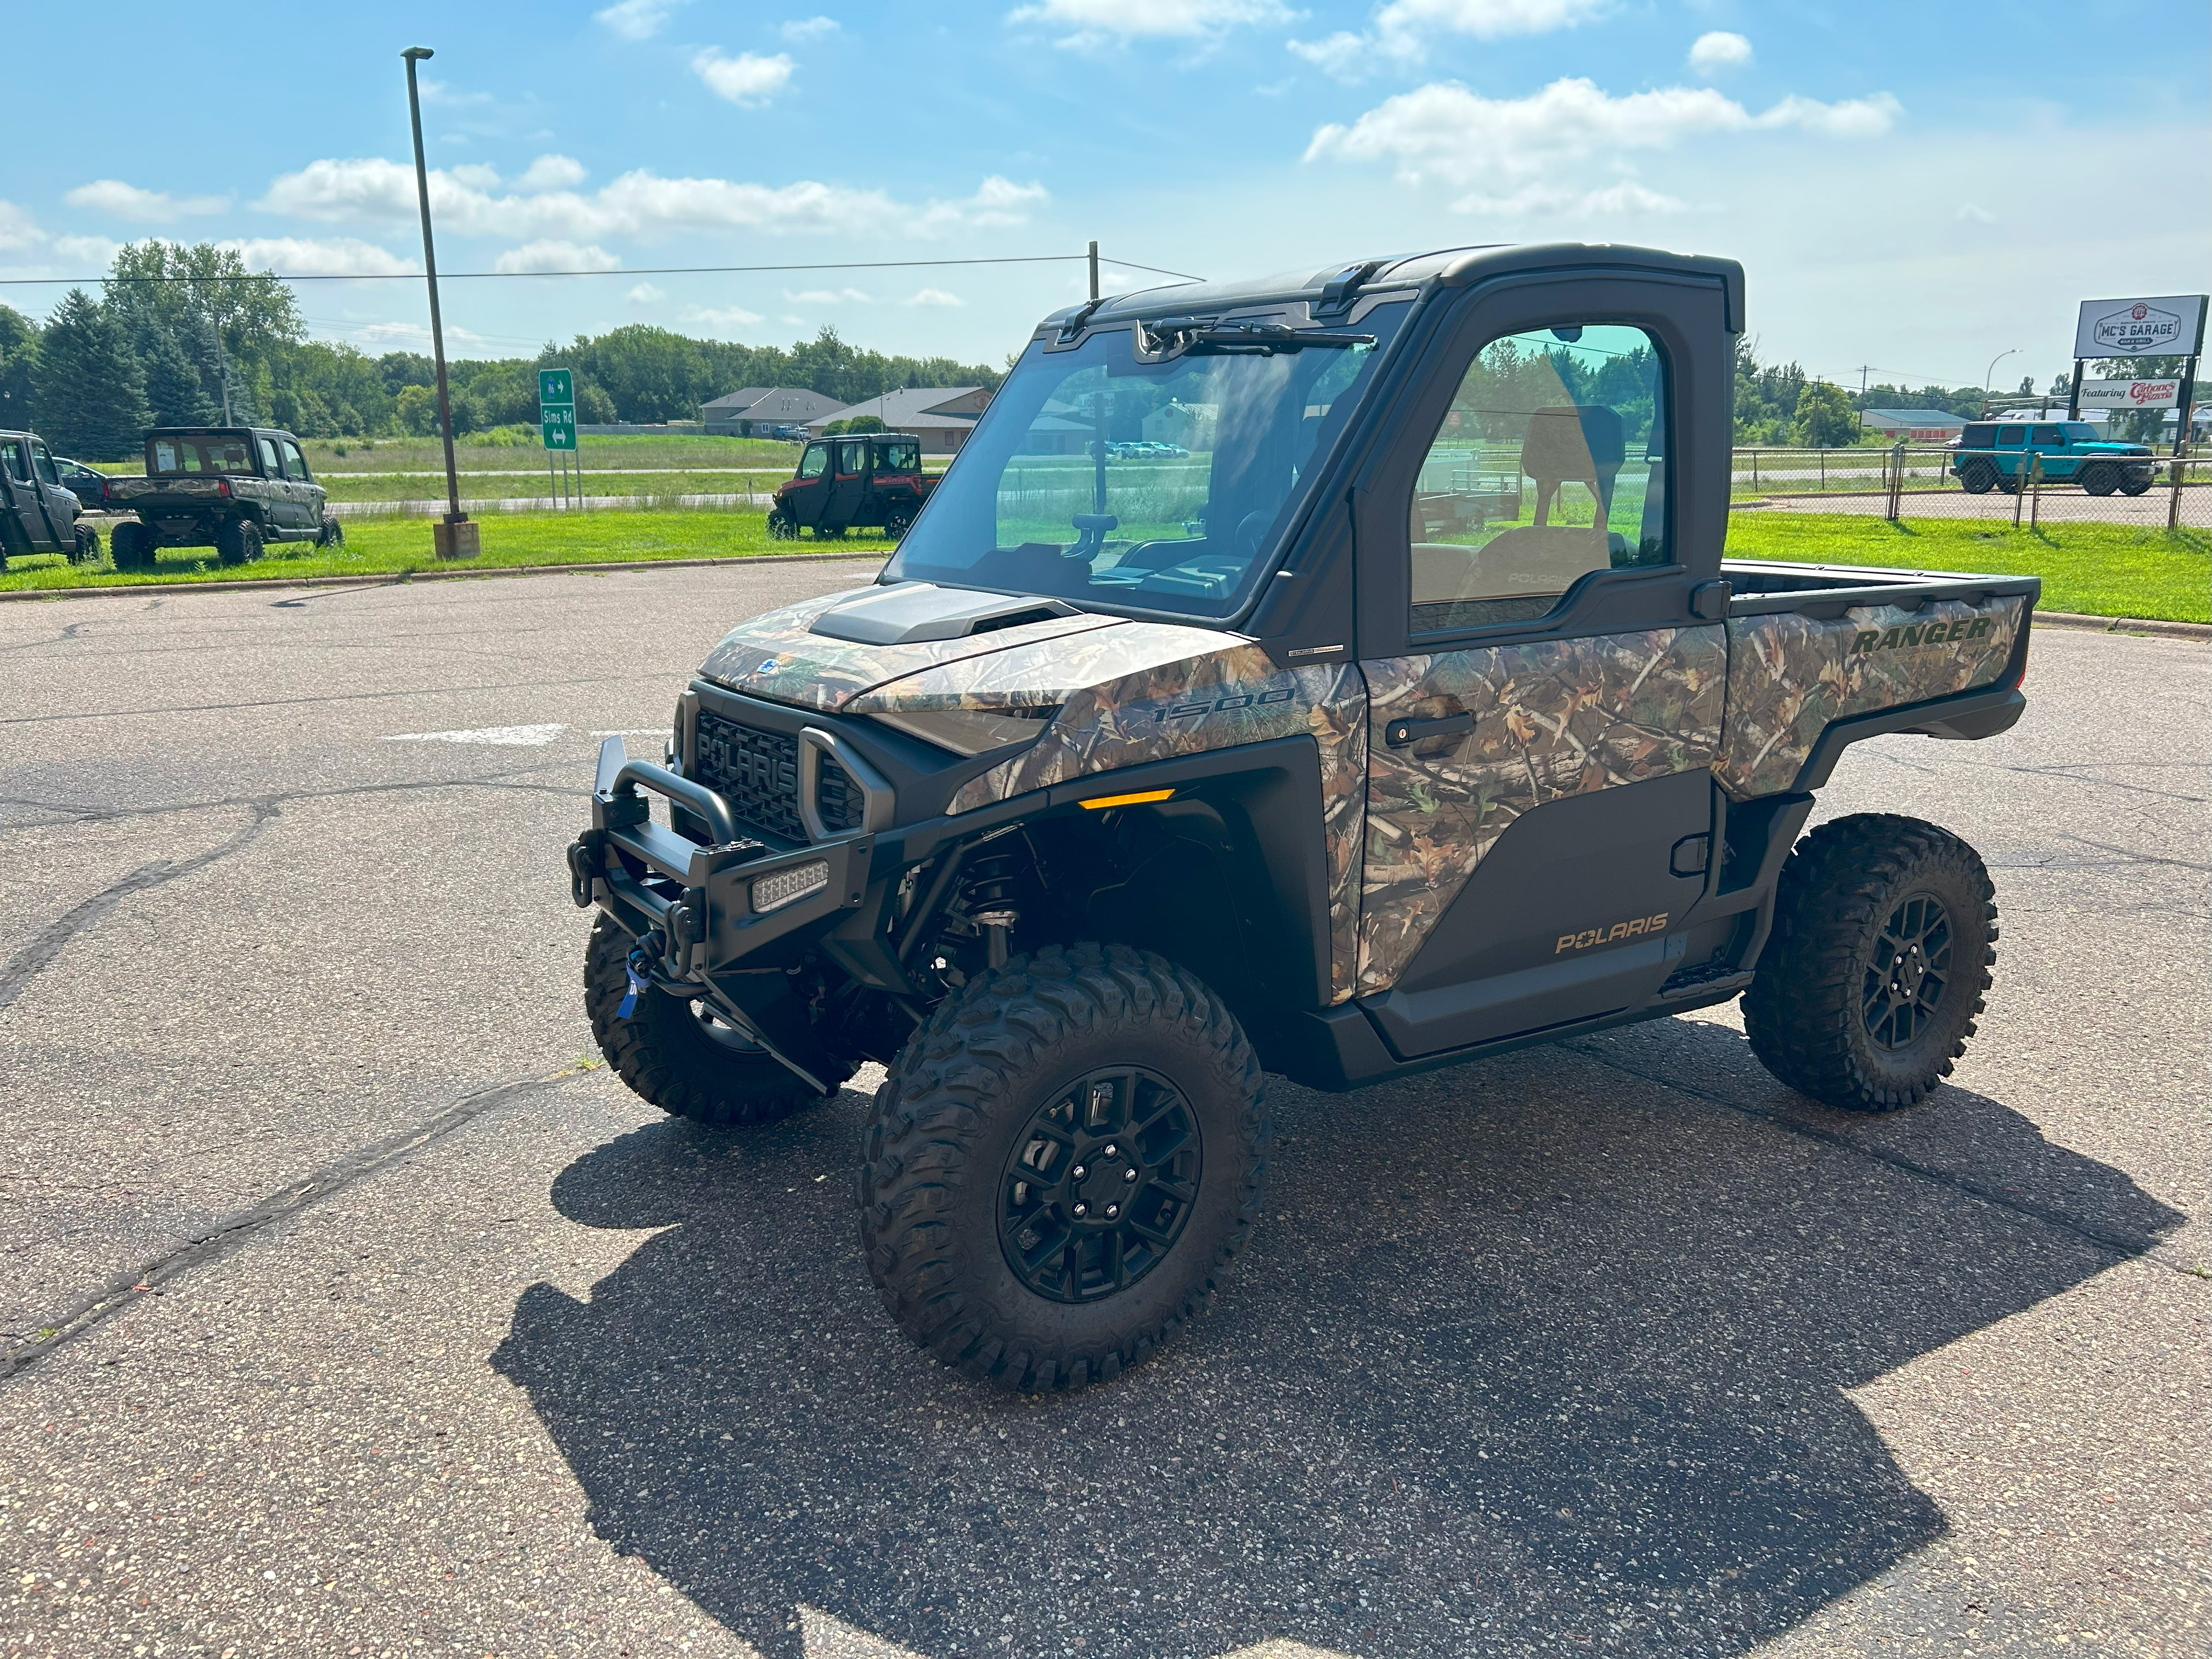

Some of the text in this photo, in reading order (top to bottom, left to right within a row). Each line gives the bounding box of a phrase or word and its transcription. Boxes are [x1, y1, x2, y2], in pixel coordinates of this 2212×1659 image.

[2102, 324, 2173, 336] MC'S GARAGE
[2081, 388, 2126, 400] Featuring
[544, 410, 572, 424] Sims Rd
[1848, 616, 1991, 656] RANGER
[1153, 687, 1295, 723] 1500
[698, 732, 797, 794] POLARIS
[1555, 912, 1668, 954] POLARIS
